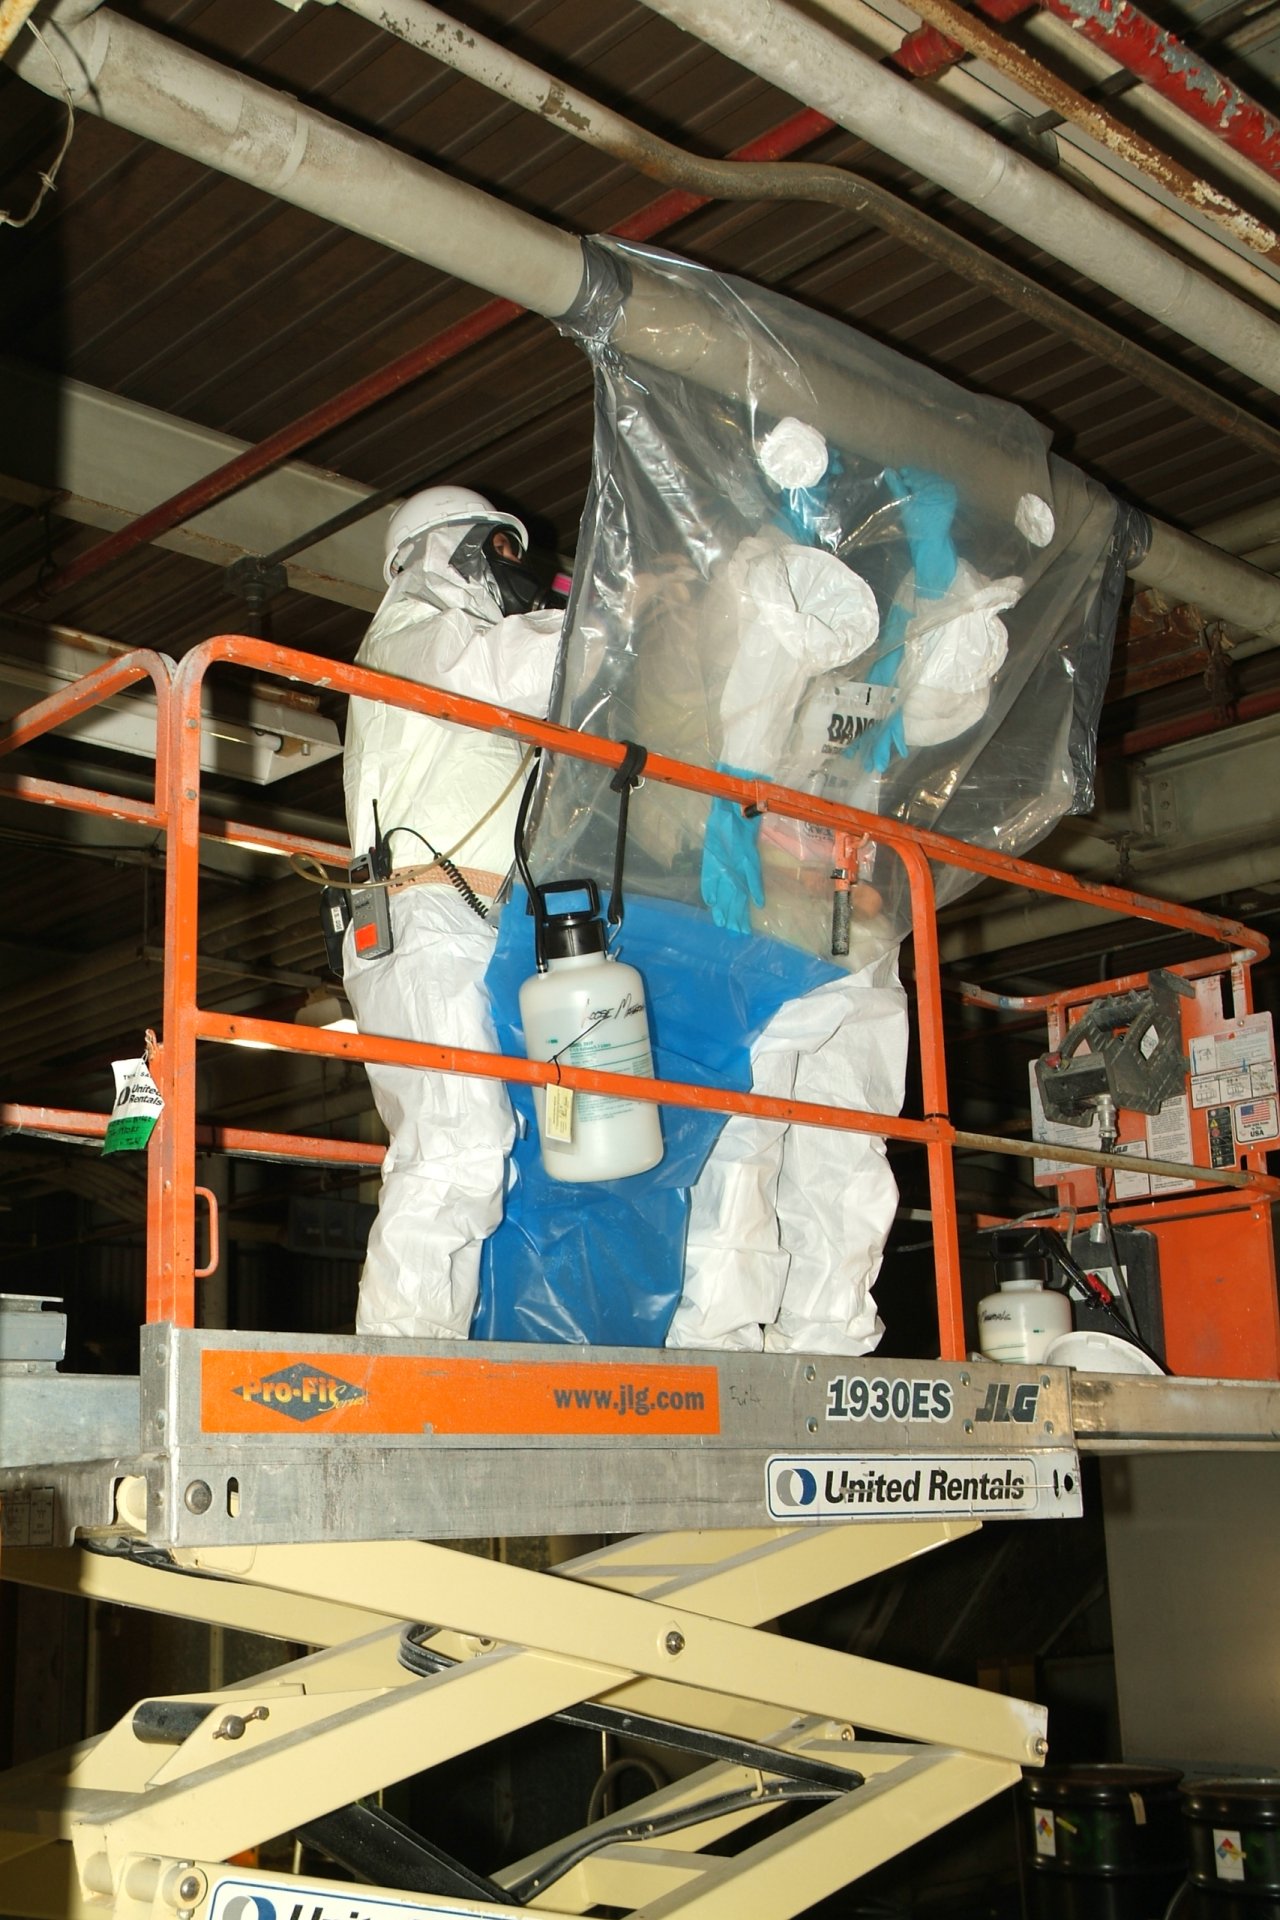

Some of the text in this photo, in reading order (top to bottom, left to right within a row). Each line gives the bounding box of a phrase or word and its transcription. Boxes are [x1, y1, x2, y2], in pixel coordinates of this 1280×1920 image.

[129, 1094, 163, 1106] Rentals
[241, 1375, 338, 1403] Pro-Fit
[553, 1383, 705, 1416] www.jlg.com
[826, 1377, 953, 1421] 1930ES
[974, 1383, 1040, 1423] JLG
[825, 1468, 1025, 1504] United Rentals
